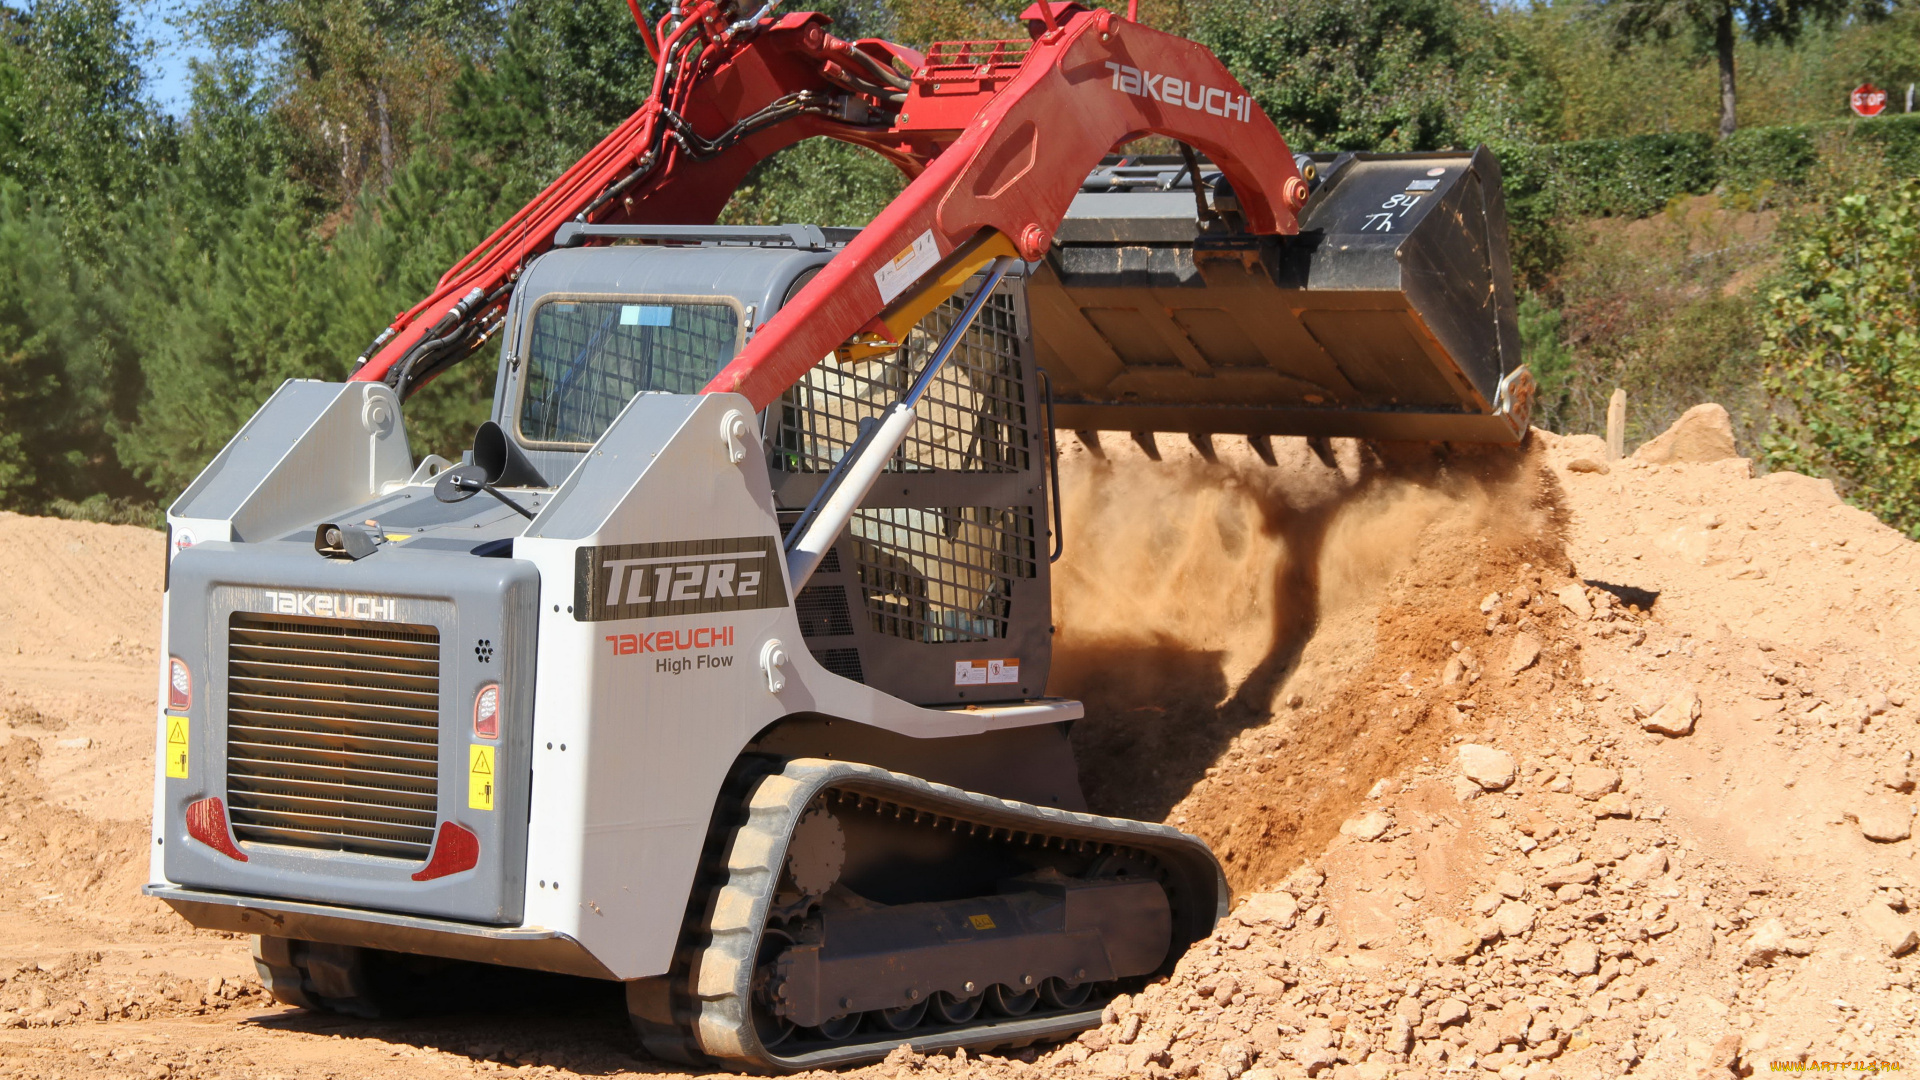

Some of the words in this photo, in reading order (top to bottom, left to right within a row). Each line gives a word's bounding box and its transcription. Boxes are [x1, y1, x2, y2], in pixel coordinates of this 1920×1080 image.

[1854, 93, 1885, 106] STOP
[1382, 194, 1421, 217] 84
[602, 550, 767, 606] TL12R2
[656, 657, 692, 675] High
[697, 655, 733, 669] Flow
